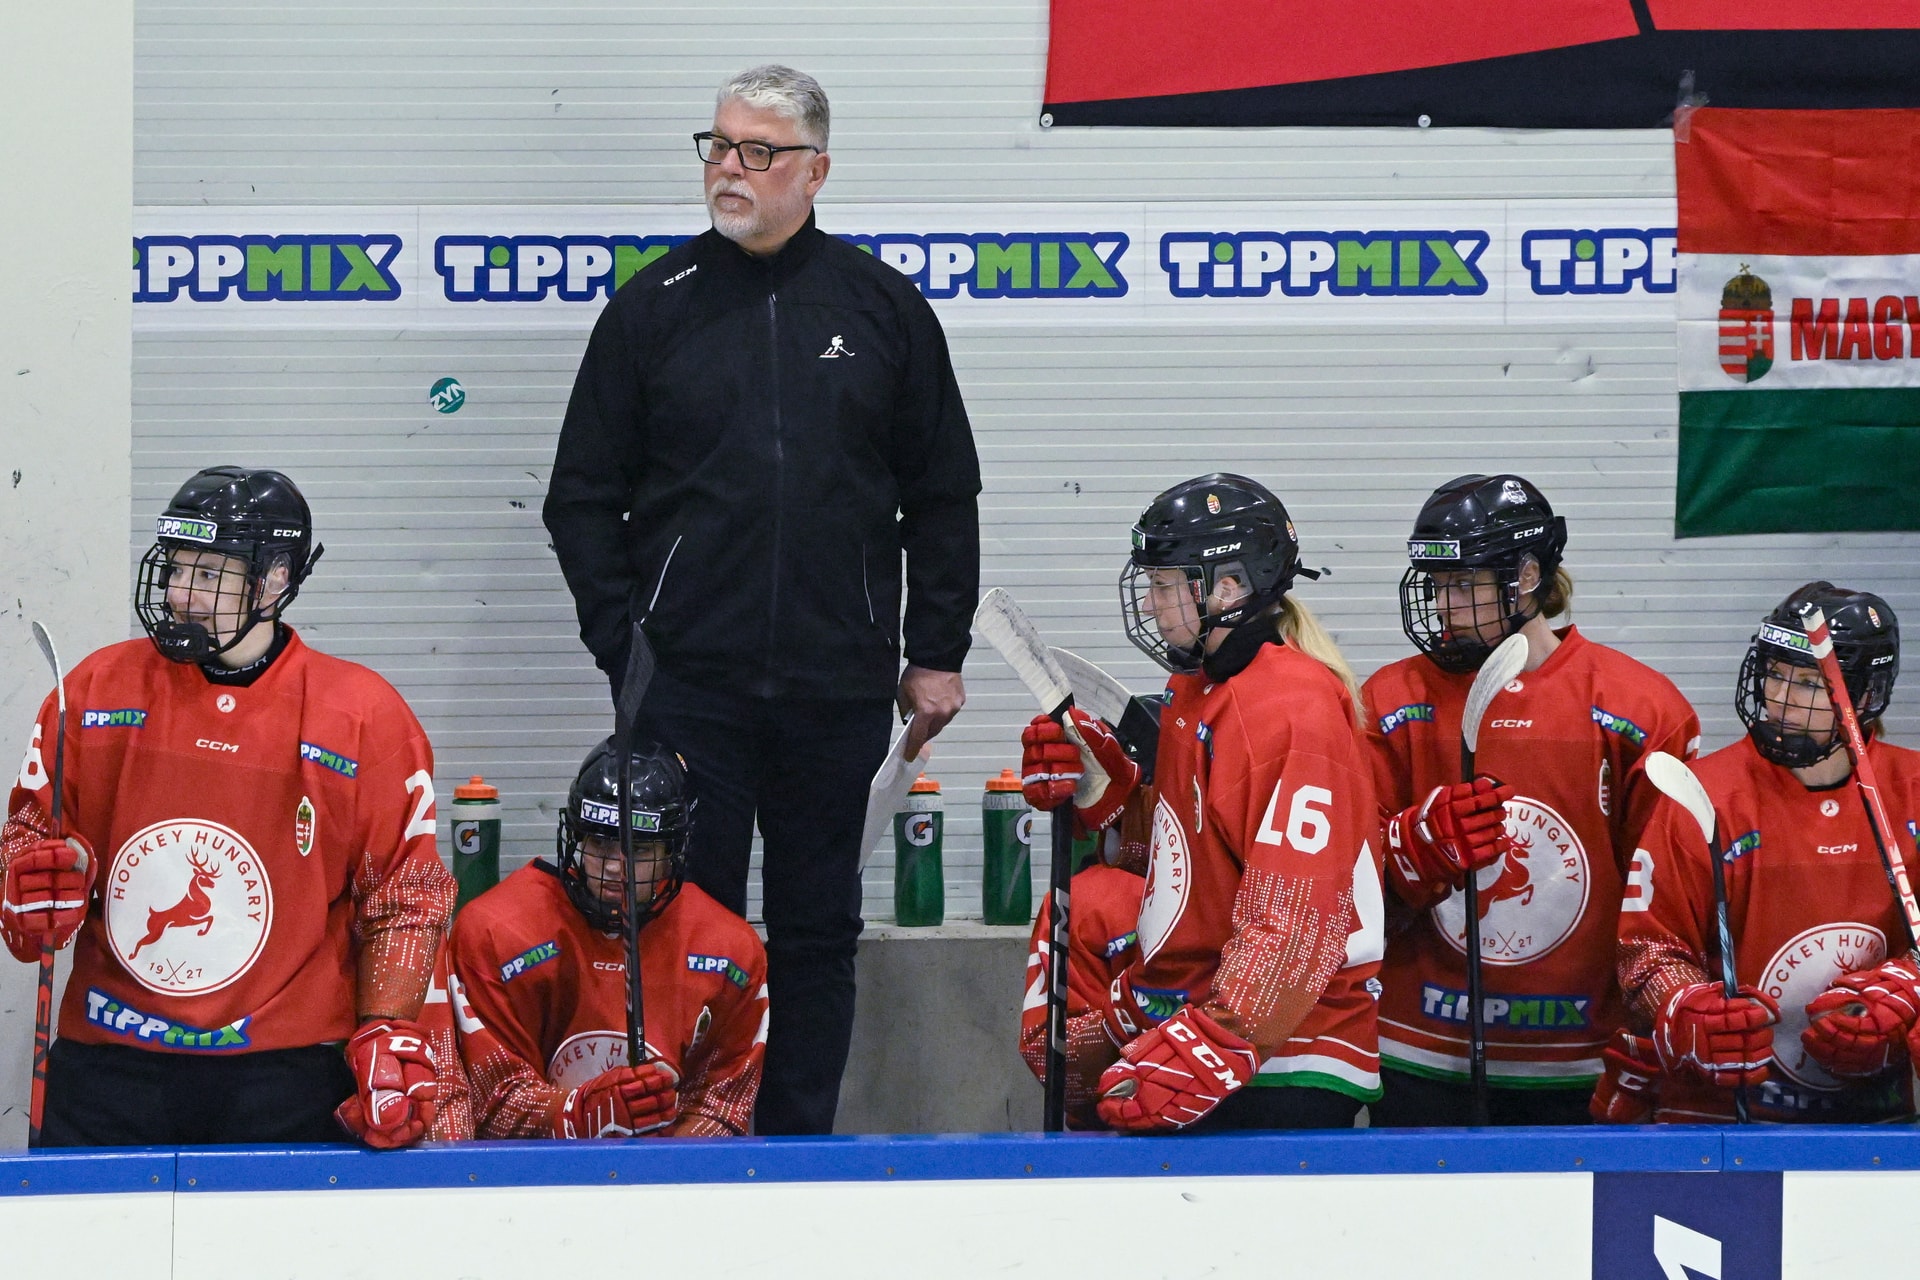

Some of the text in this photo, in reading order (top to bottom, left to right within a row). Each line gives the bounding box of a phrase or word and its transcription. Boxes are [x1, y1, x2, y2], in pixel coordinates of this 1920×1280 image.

[132, 243, 393, 292] PPMIX
[443, 244, 672, 293] TiPPM
[858, 241, 1123, 290] PPMIX
[1168, 240, 1482, 289] TiPPMIX
[1529, 236, 1678, 286] TiPP
[663, 263, 699, 287] CCM
[272, 528, 302, 539] CCM
[1513, 526, 1545, 540] CCM
[1202, 542, 1242, 557] CCM
[1408, 542, 1456, 557] iPPMIX
[1220, 609, 1243, 623] CCM
[1763, 625, 1810, 650] TiPPMI
[1871, 654, 1894, 667] CCM
[82, 709, 148, 728] PPMIX
[1490, 718, 1534, 730] CCM
[194, 738, 240, 754] CCM
[301, 742, 359, 779] PPMIX
[582, 803, 659, 830] TiPPIX
[904, 812, 935, 847] G
[454, 820, 482, 855] G
[1817, 843, 1858, 855] CCM
[112, 829, 262, 924] HOCKEY HUNGARY
[1482, 935, 1533, 948] 19 27
[148, 961, 203, 980] 19 27
[501, 941, 560, 983] PPMIX
[1768, 936, 1825, 1000] OCKEY
[86, 989, 252, 1048] TiPPMIX
[551, 1041, 598, 1089] OCKEY
[1166, 1019, 1243, 1091] CCM
[380, 1096, 403, 1112] CCM
